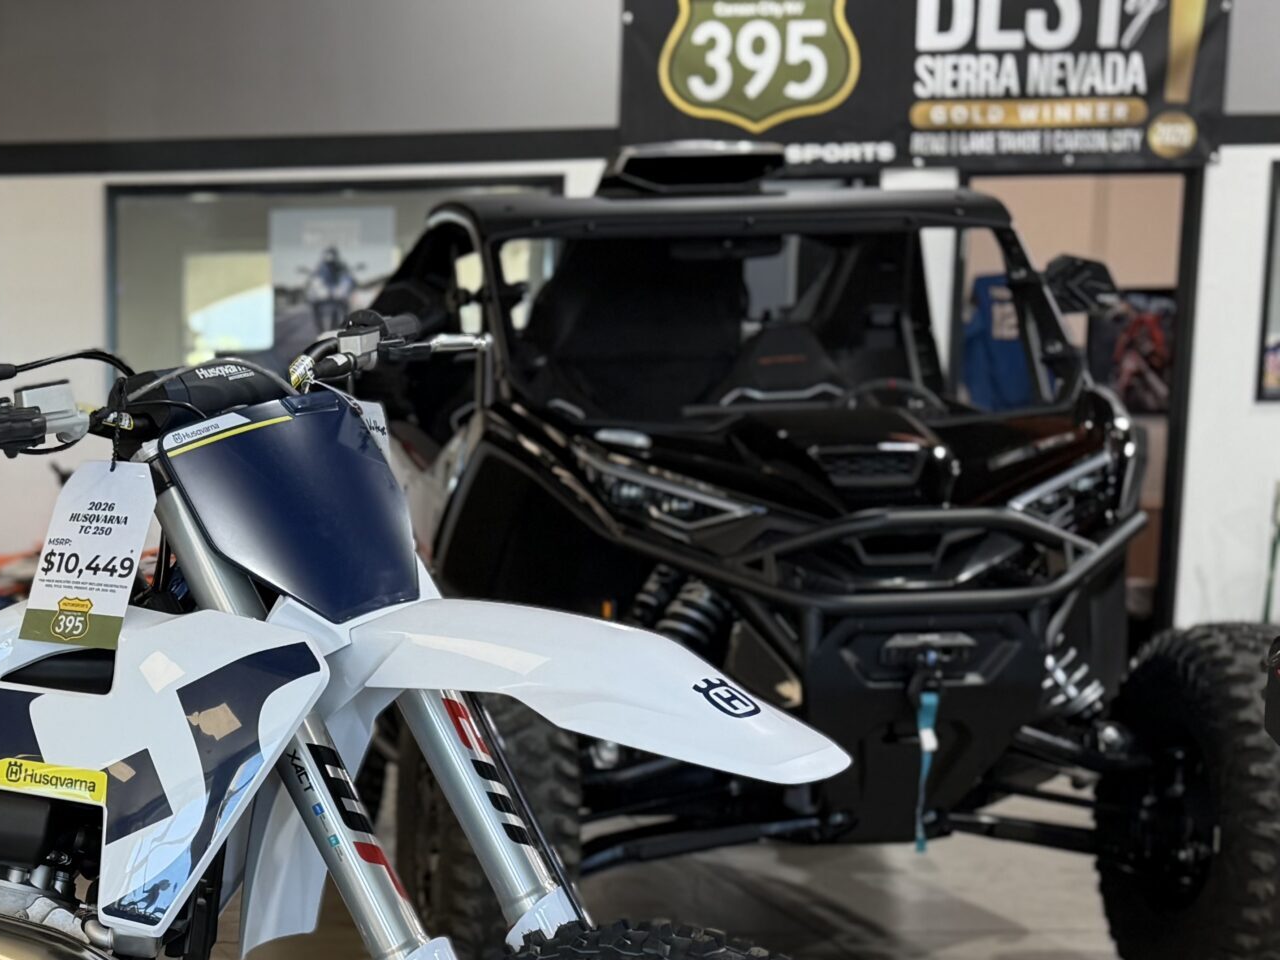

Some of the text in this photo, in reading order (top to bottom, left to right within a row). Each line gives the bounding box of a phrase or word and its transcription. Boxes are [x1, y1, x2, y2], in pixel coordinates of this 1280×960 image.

[687, 20, 828, 101] 395
[913, 51, 1147, 98] SIERRA NEVADA
[929, 102, 1129, 125] GOLD WINNER
[182, 423, 220, 442] Husqvarna
[87, 501, 116, 512] 2026
[69, 513, 129, 525] HUSQVARNA
[79, 525, 113, 536] TC 250
[41, 549, 135, 579] $10,449
[55, 615, 85, 634] 395
[24, 768, 97, 792] Husqvarna
[287, 749, 316, 793] XACT
